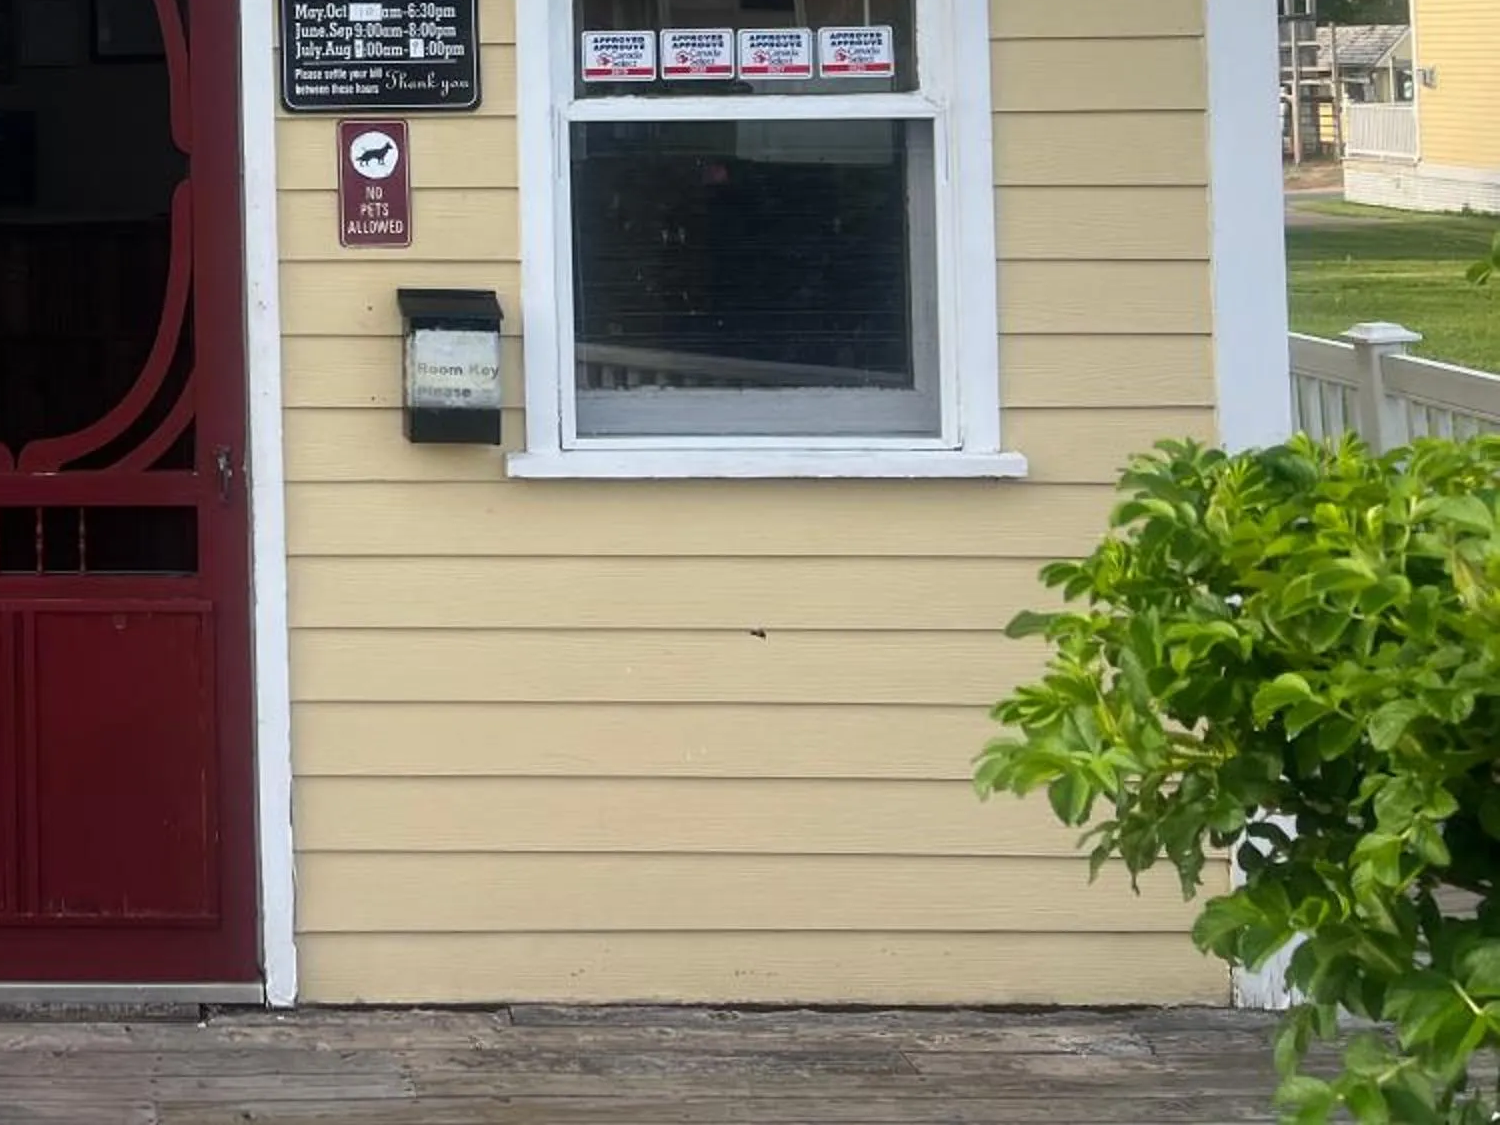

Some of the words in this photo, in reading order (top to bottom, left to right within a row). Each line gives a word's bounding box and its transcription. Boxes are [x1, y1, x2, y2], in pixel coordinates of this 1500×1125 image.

[295, 22, 352, 40] June.Sep
[671, 34, 723, 42] APPROVED
[829, 32, 882, 40] APPROVED
[593, 36, 645, 44] APPROVED
[295, 41, 351, 59] July.Aug
[295, 68, 322, 80] Please
[349, 69, 367, 81] your
[369, 67, 382, 79] bill
[295, 84, 330, 95] between
[332, 83, 354, 95] these
[355, 83, 379, 94] hours
[385, 70, 437, 90] Thank
[441, 79, 469, 97] you
[365, 187, 383, 200] NO
[360, 203, 389, 218] PETS
[347, 220, 403, 235] ALLOWED
[417, 363, 463, 376] Room
[469, 364, 499, 379] Key
